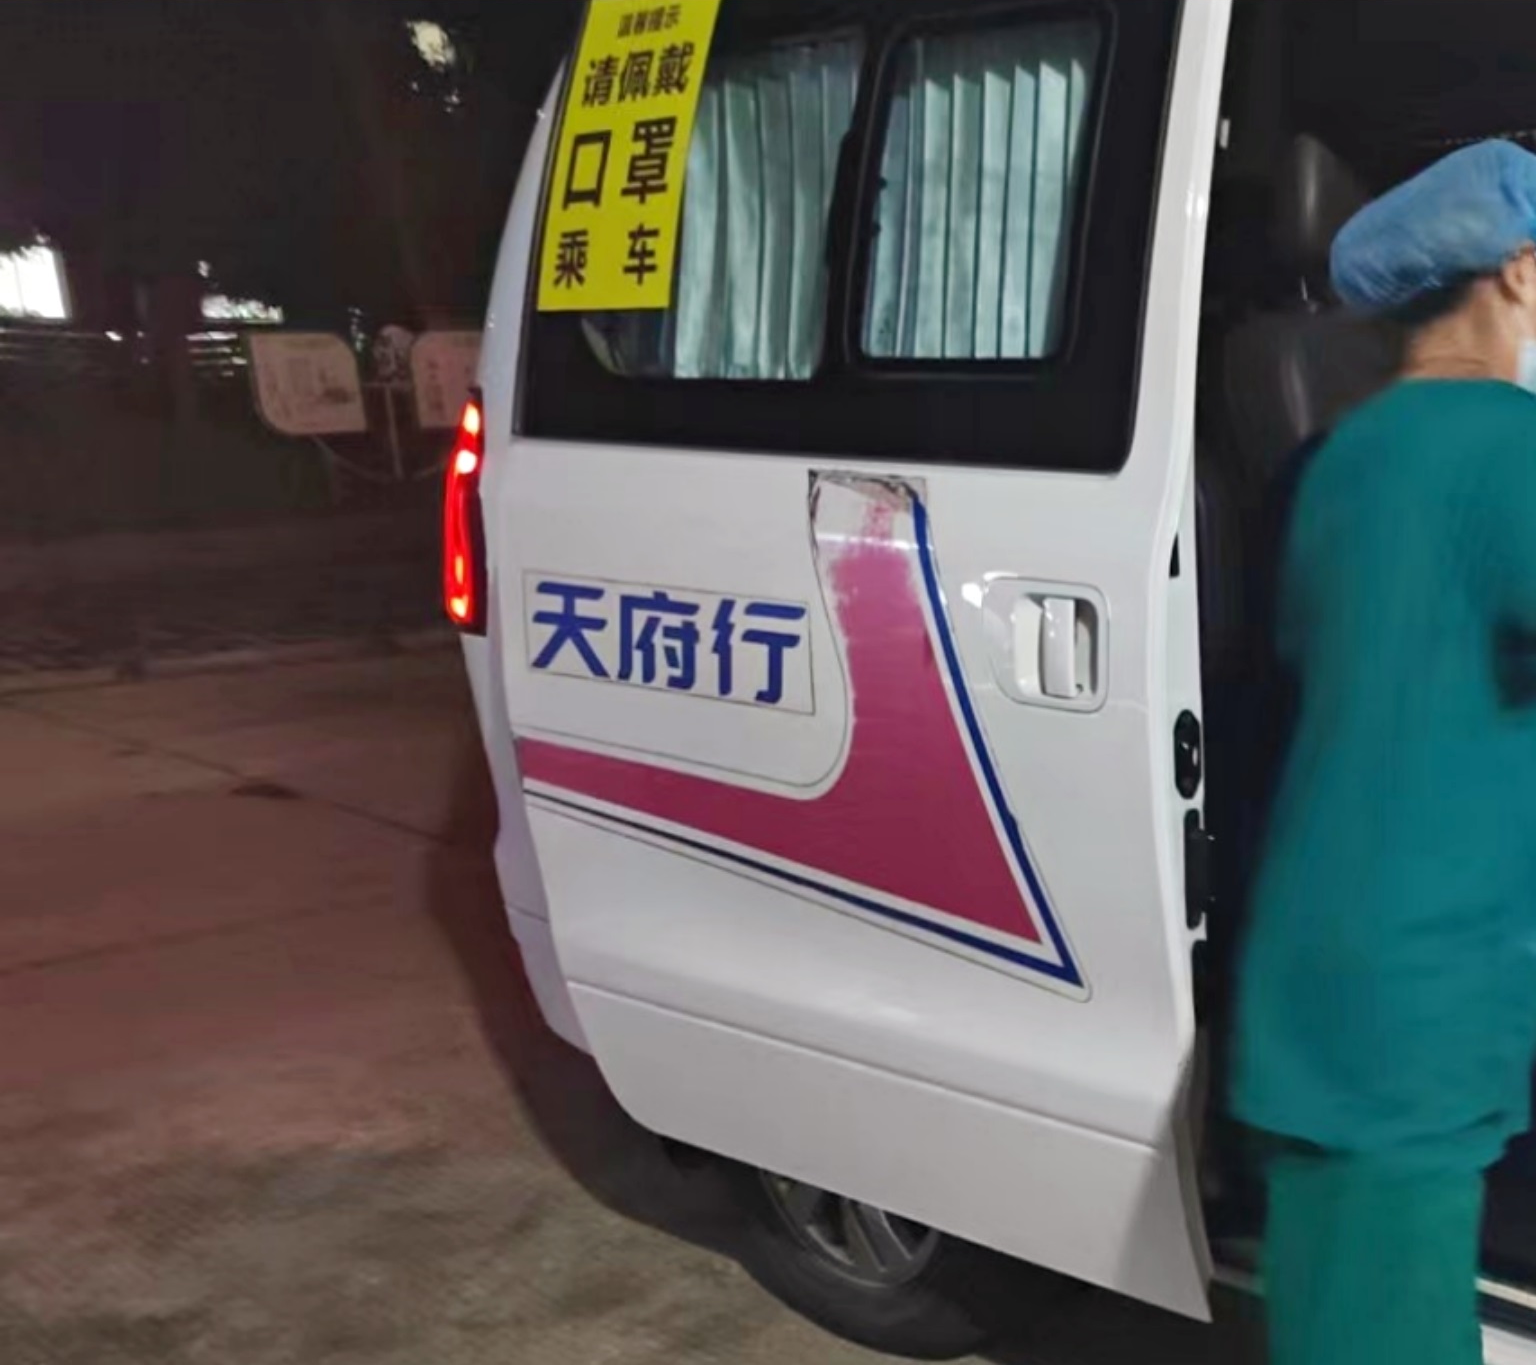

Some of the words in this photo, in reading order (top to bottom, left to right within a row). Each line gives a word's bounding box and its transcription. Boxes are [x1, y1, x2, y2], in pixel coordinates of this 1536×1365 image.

[581, 41, 695, 108] 请佩戴
[562, 115, 678, 212] 口罩
[552, 223, 661, 290] 乘车
[530, 580, 808, 706] 天府行
